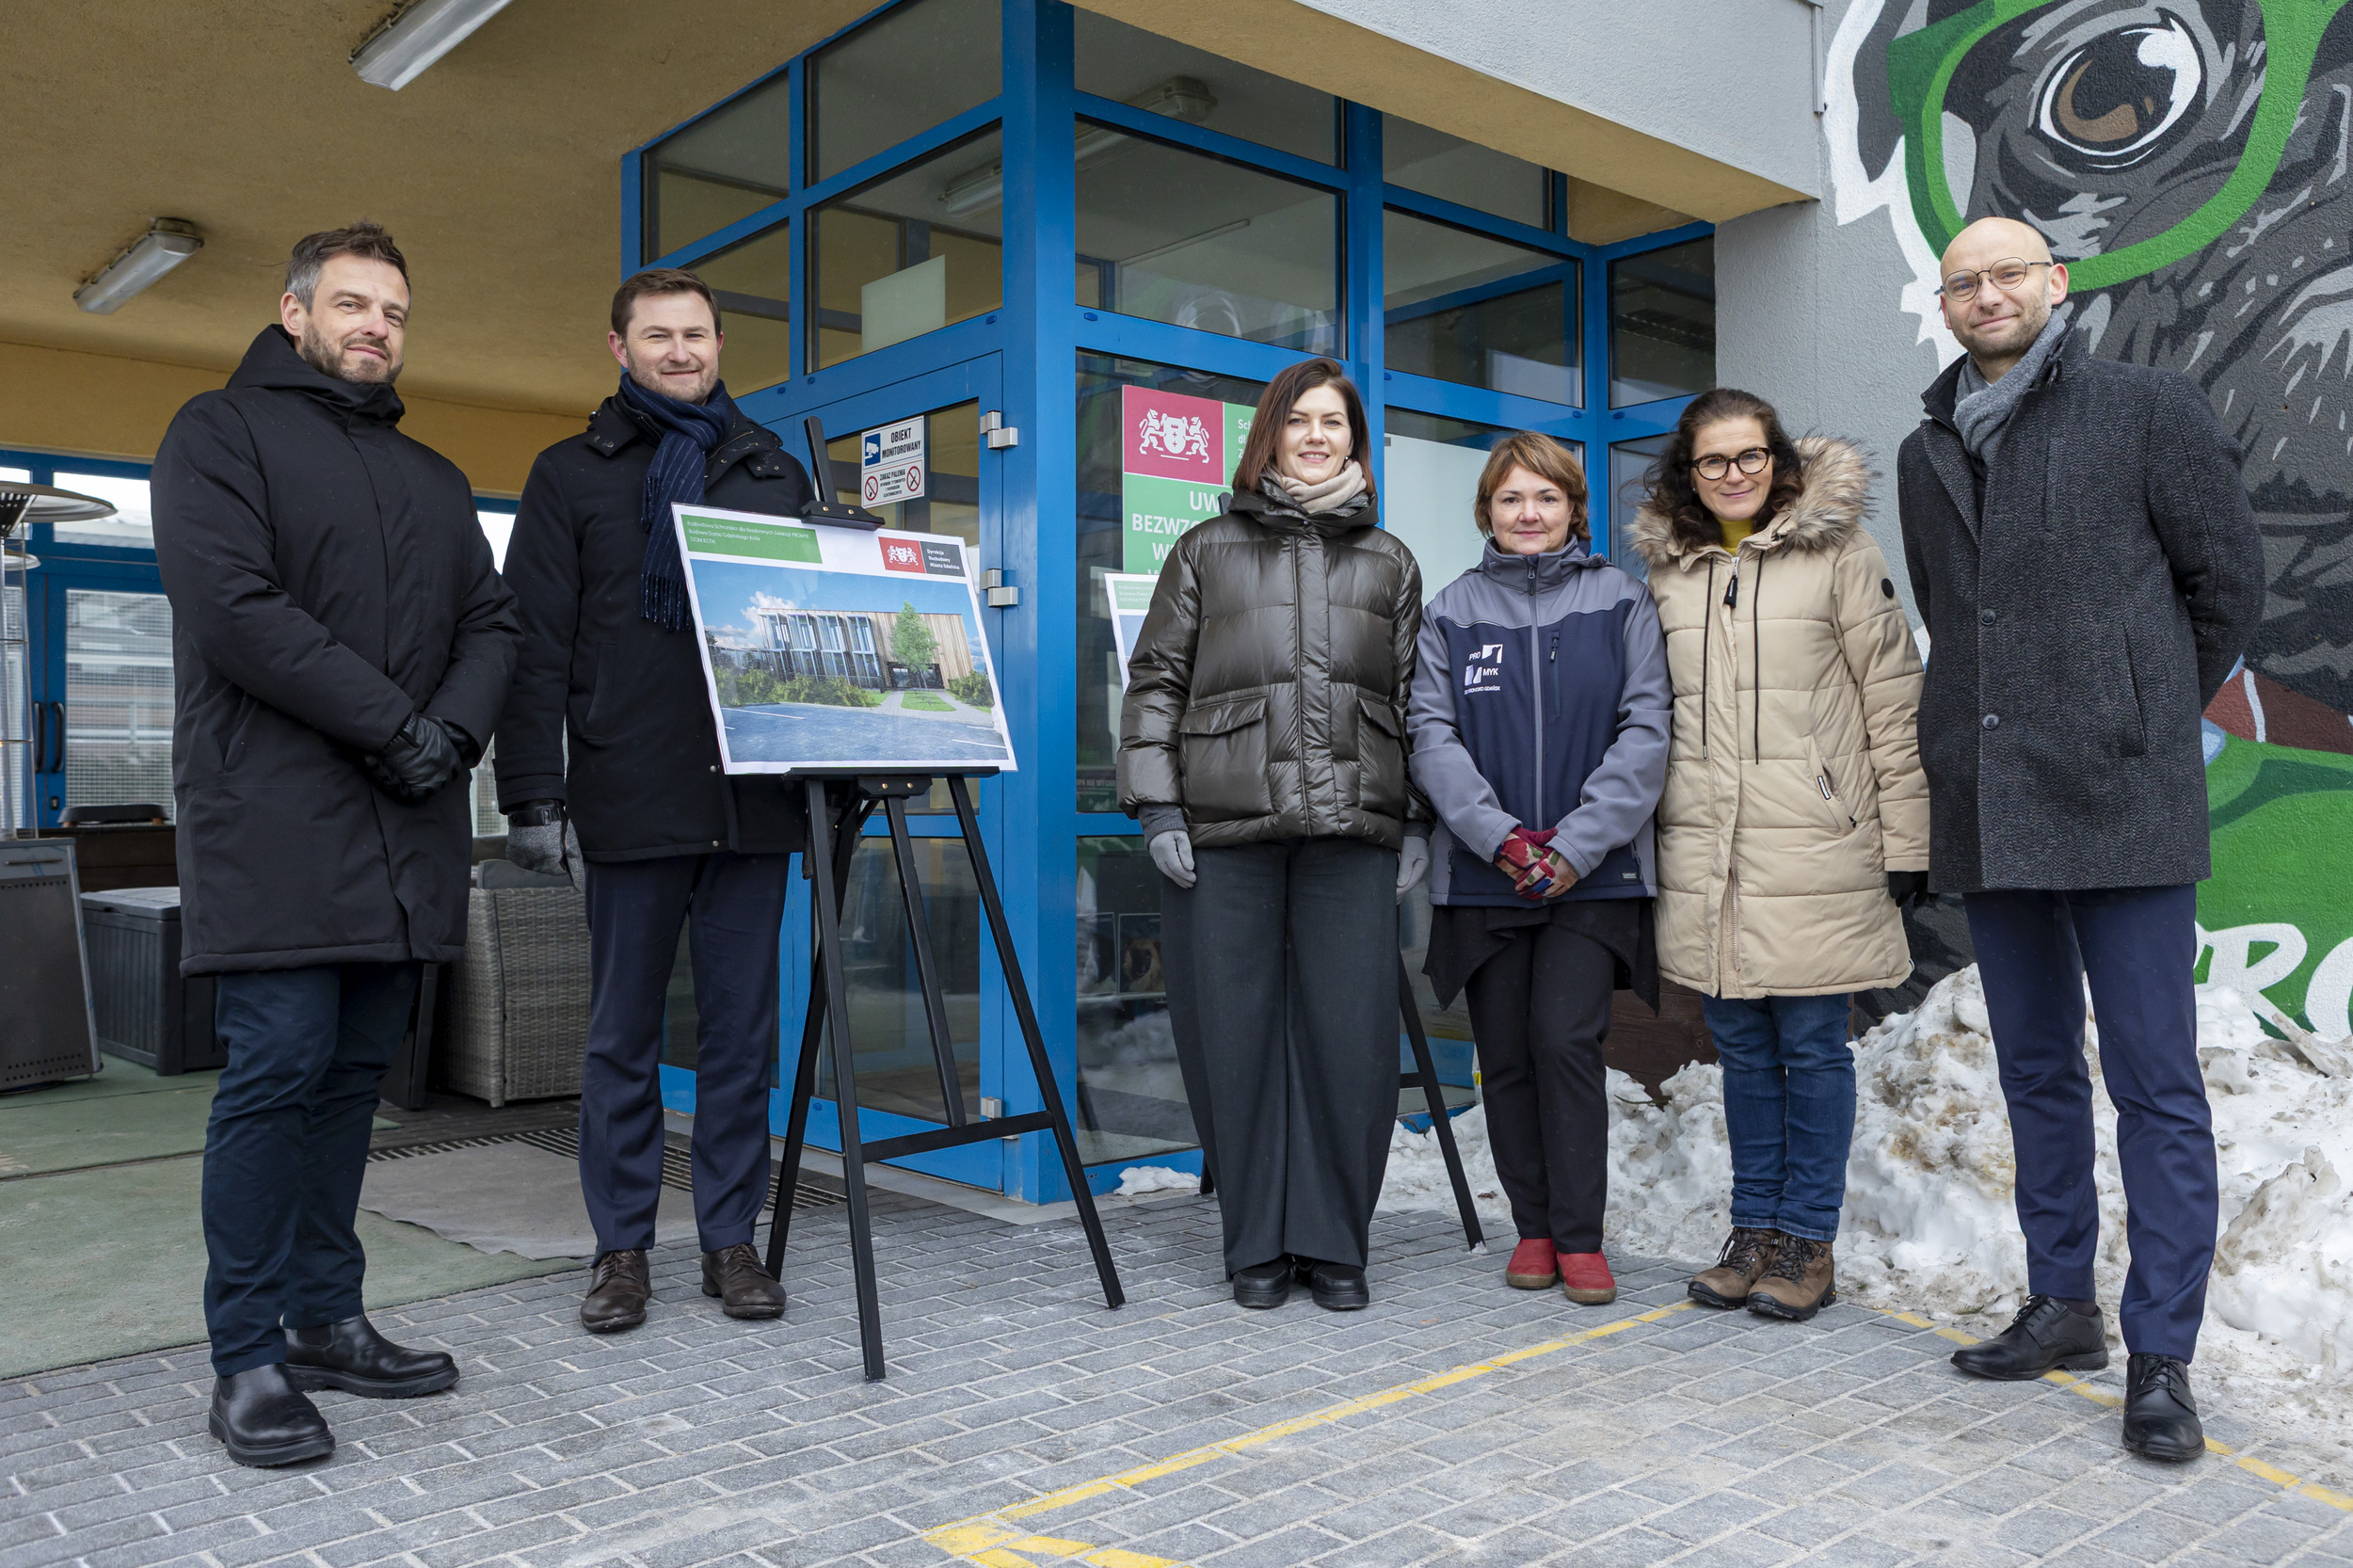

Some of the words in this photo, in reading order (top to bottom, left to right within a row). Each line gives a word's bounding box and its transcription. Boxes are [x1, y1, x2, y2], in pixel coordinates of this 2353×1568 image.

[890, 427, 912, 443] OBIEKT
[882, 440, 920, 458] MONITOROWANY
[1152, 542, 1175, 562] W
[1469, 651, 1481, 661] PRO
[1482, 667, 1498, 676] MYK
